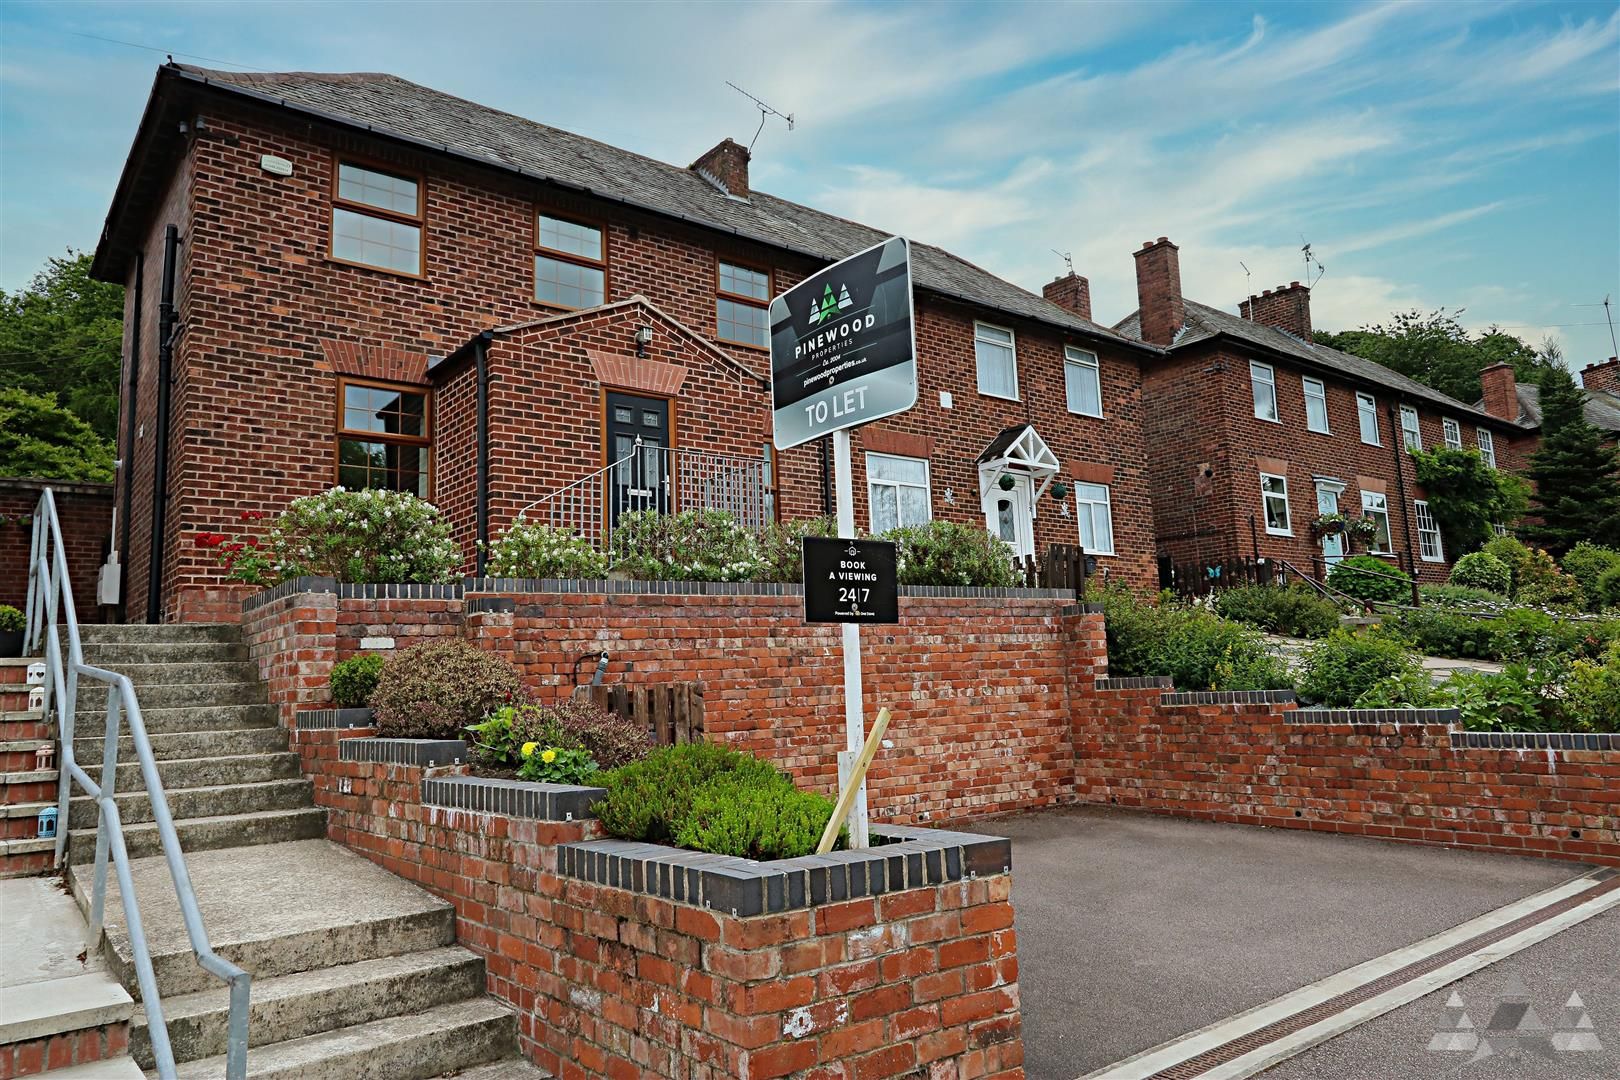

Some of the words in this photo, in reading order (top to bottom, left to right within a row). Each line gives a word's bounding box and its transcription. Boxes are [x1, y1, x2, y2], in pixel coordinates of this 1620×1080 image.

[795, 314, 875, 359] PINEWOOD
[811, 338, 853, 361] PROPERTIES
[803, 357, 867, 388] pinewoodproperties.co.uk
[805, 401, 828, 427] TO
[834, 386, 868, 418] LET
[829, 571, 836, 580] A
[838, 572, 877, 581] VIEWING
[840, 561, 866, 569] BOOK
